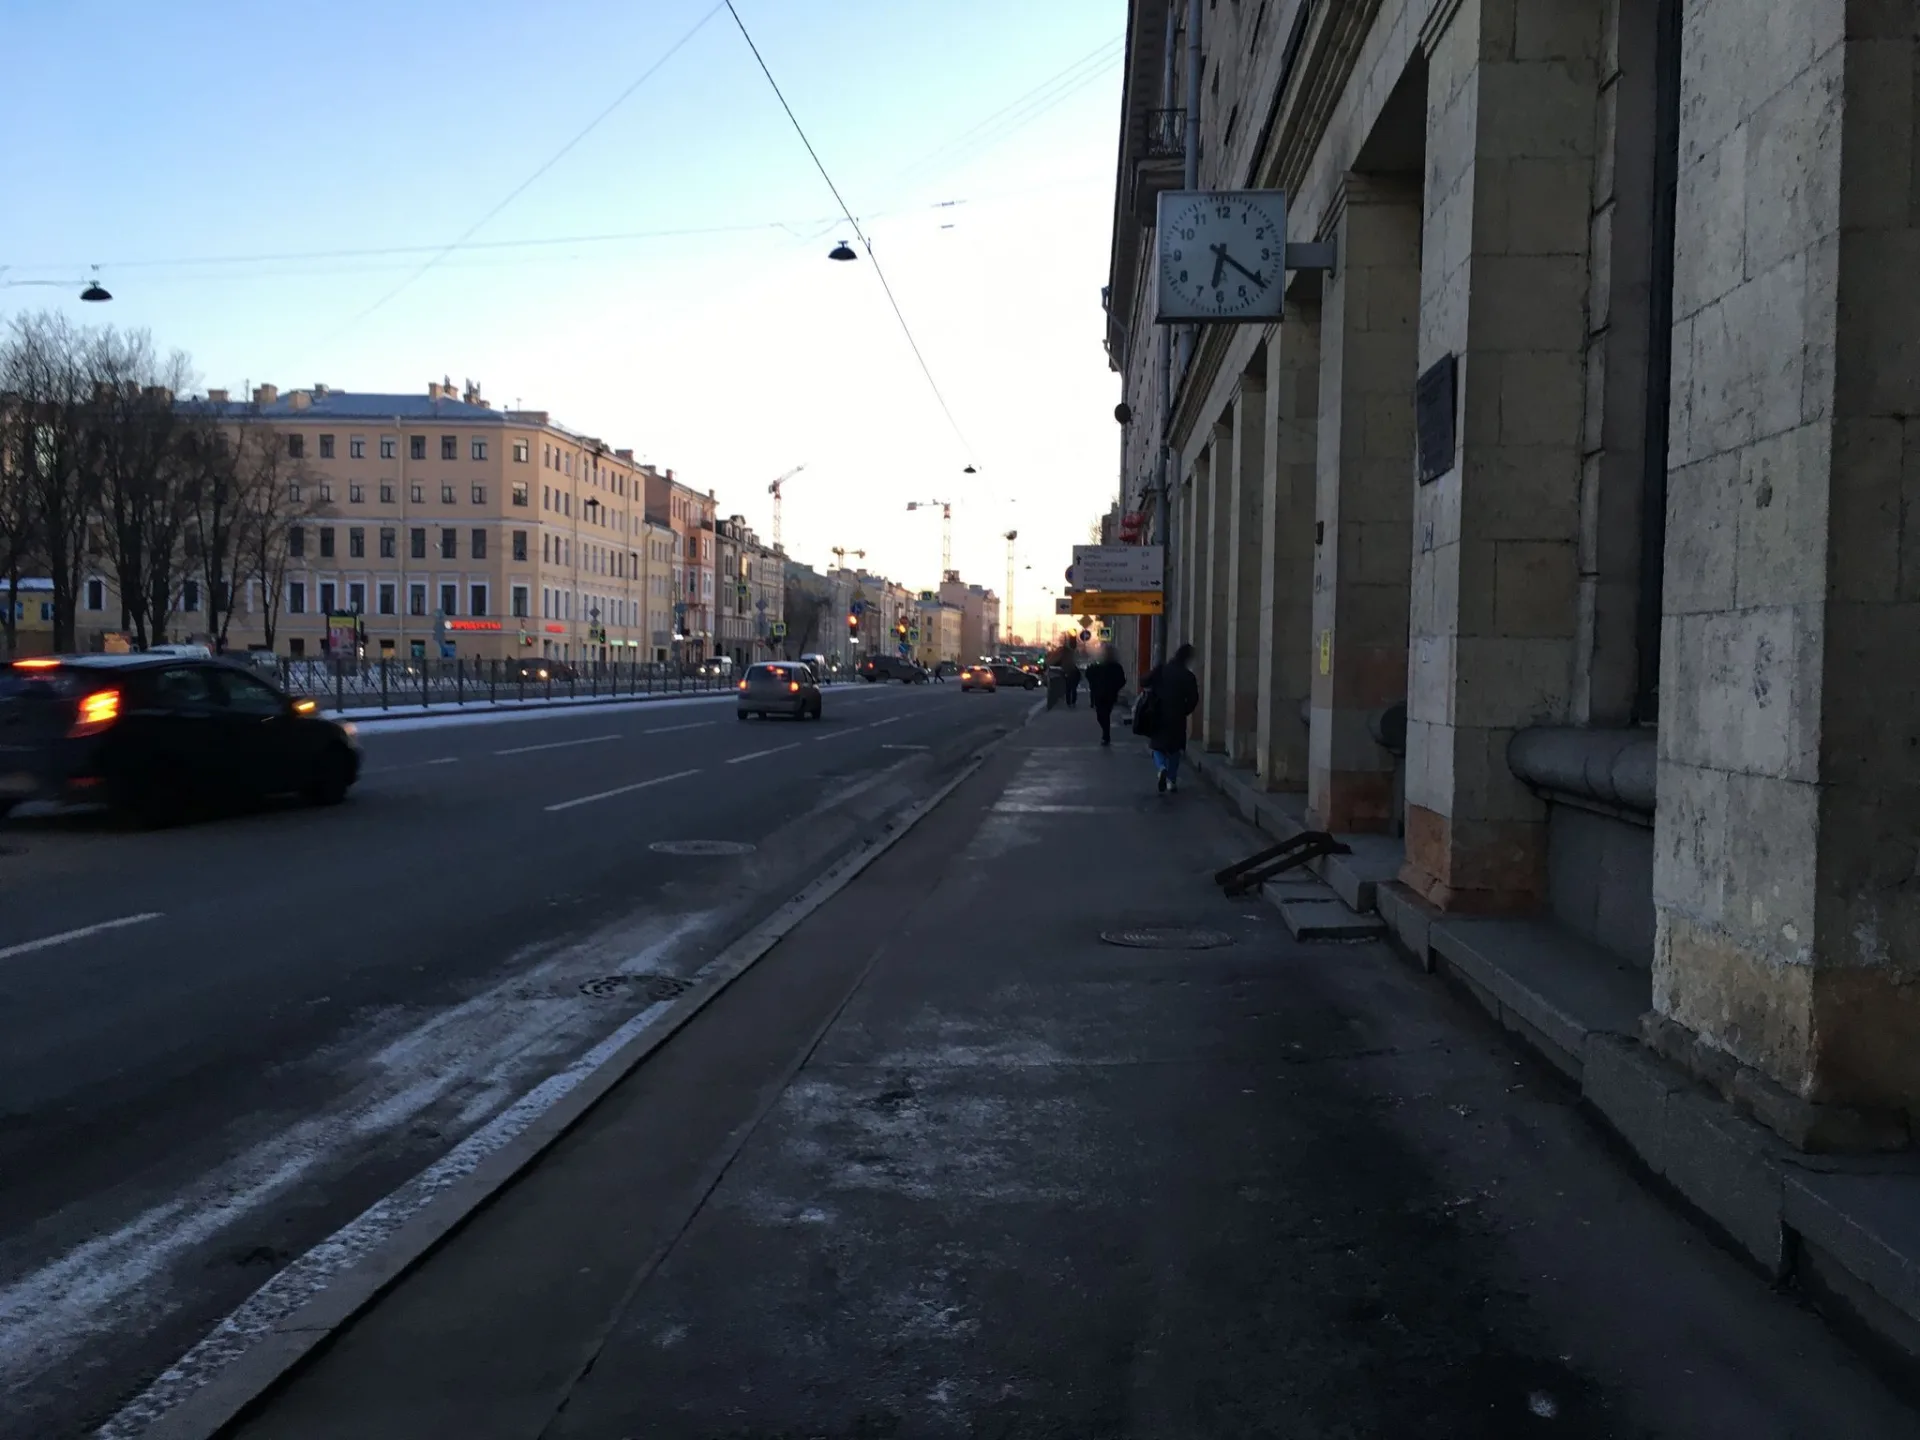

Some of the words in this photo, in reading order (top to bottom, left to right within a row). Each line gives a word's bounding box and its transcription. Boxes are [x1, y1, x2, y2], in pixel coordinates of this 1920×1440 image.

[1194, 212, 1206, 225] 11
[1216, 206, 1231, 219] 12
[1241, 212, 1247, 225] 1
[1180, 228, 1195, 240] 10
[1255, 227, 1265, 240] 2
[1174, 249, 1182, 261] 9
[1261, 248, 1270, 261] 3
[1179, 270, 1188, 283] 8
[1195, 285, 1204, 297] 7
[1215, 290, 1225, 303] 6
[1238, 285, 1246, 297] 5
